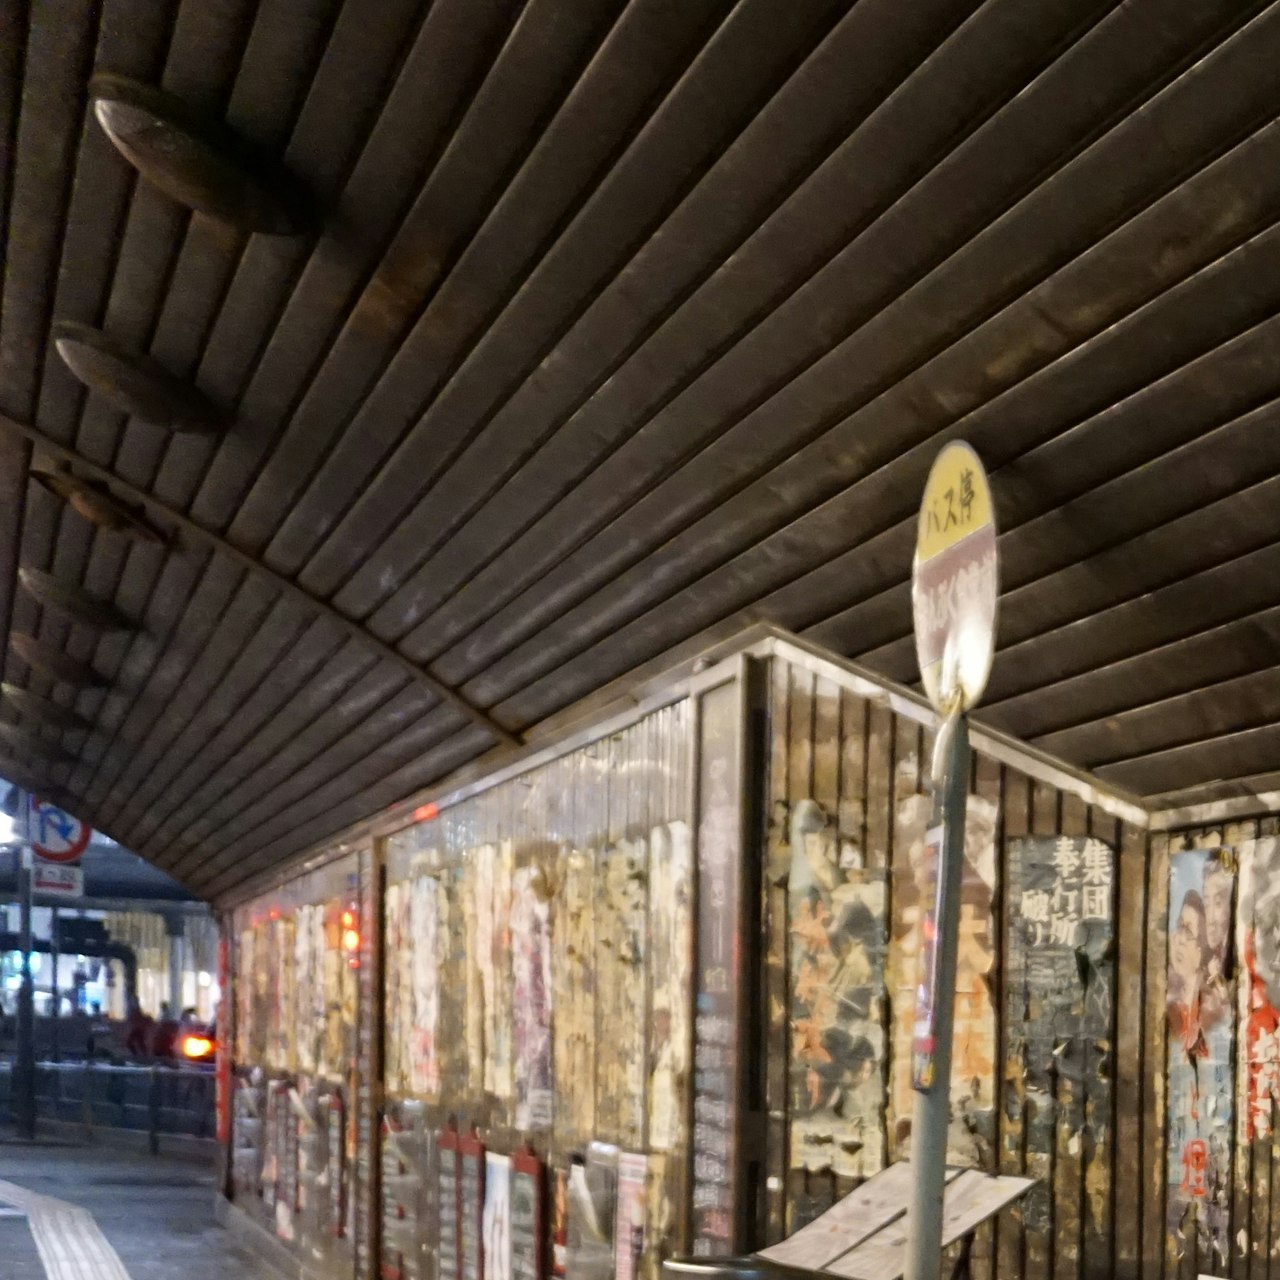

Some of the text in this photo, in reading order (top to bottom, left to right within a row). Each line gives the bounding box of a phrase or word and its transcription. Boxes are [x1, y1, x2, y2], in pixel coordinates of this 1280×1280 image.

[926, 467, 975, 538] バス停
[1081, 837, 1113, 919] 集団
